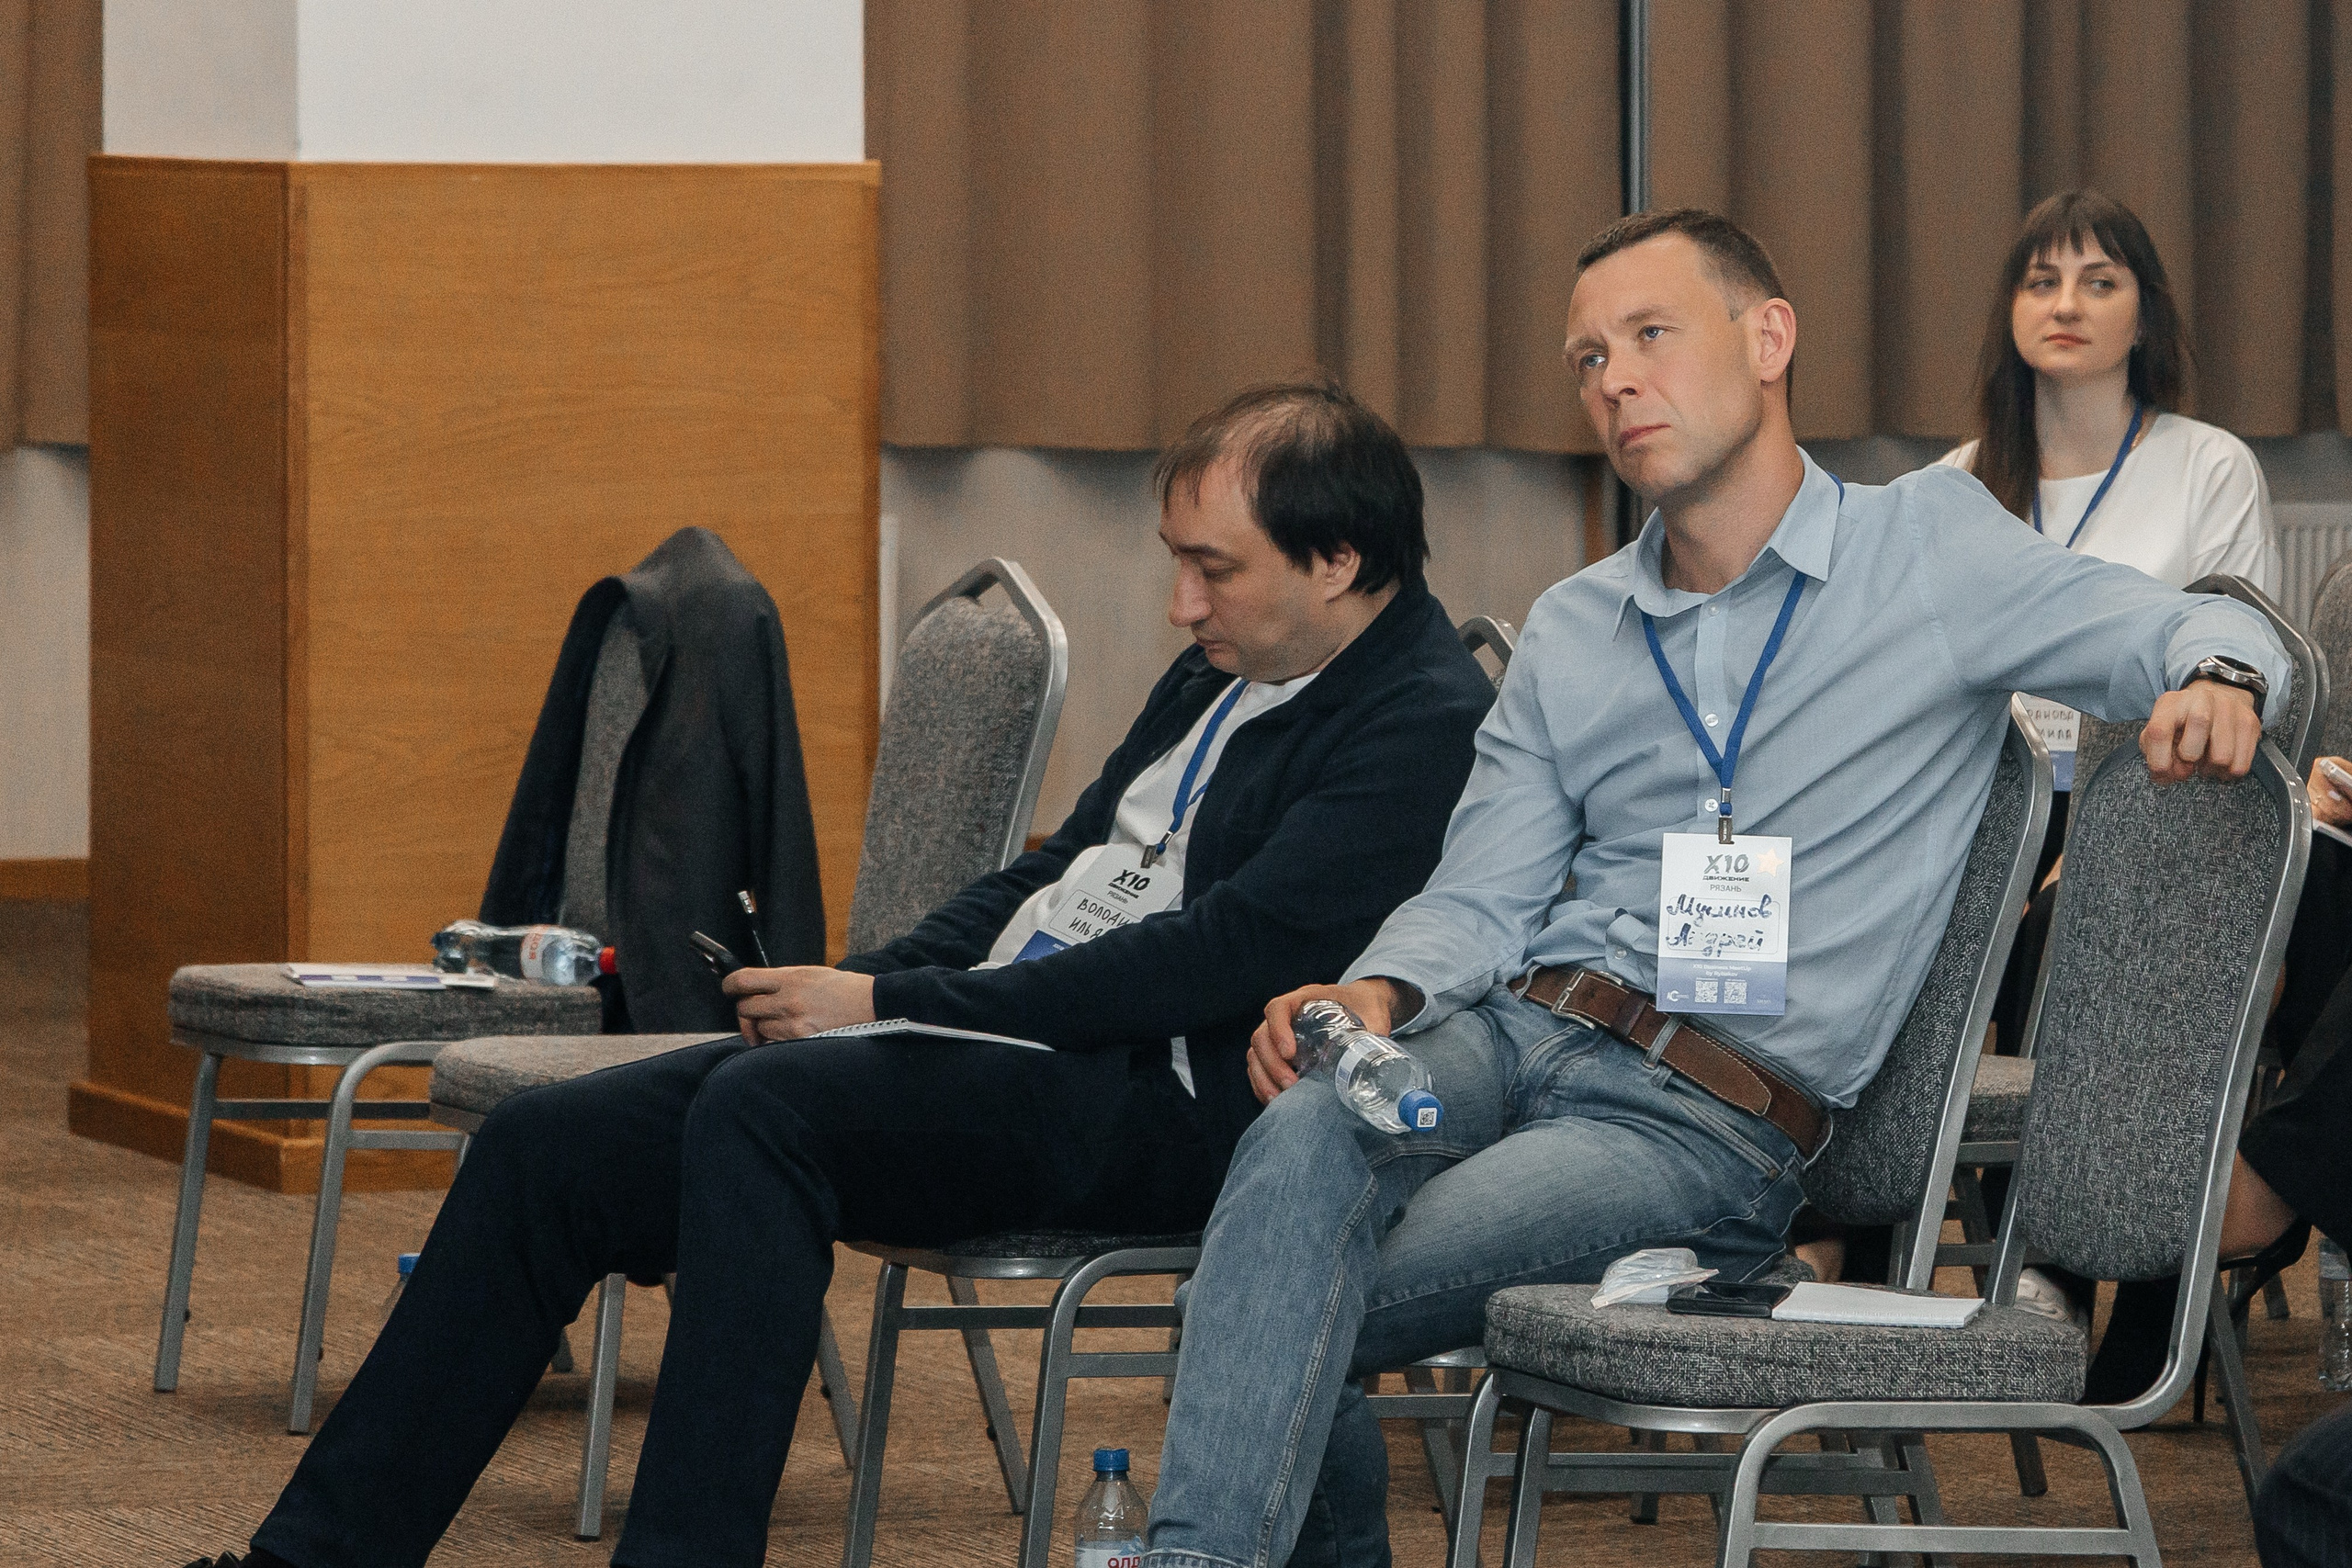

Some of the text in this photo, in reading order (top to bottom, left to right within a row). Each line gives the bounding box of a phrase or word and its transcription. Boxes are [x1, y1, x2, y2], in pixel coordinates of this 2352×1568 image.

[1703, 853, 1750, 874] X10
[1113, 869, 1151, 891] X10
[1710, 884, 1742, 893] РЯЗАНЬ
[1106, 890, 1129, 905] РЯЗАНЬ
[1077, 897, 1134, 927] ВОЛОДИ
[1069, 917, 1104, 939] ИЛЬЯ
[1665, 922, 1764, 958] Адрей
